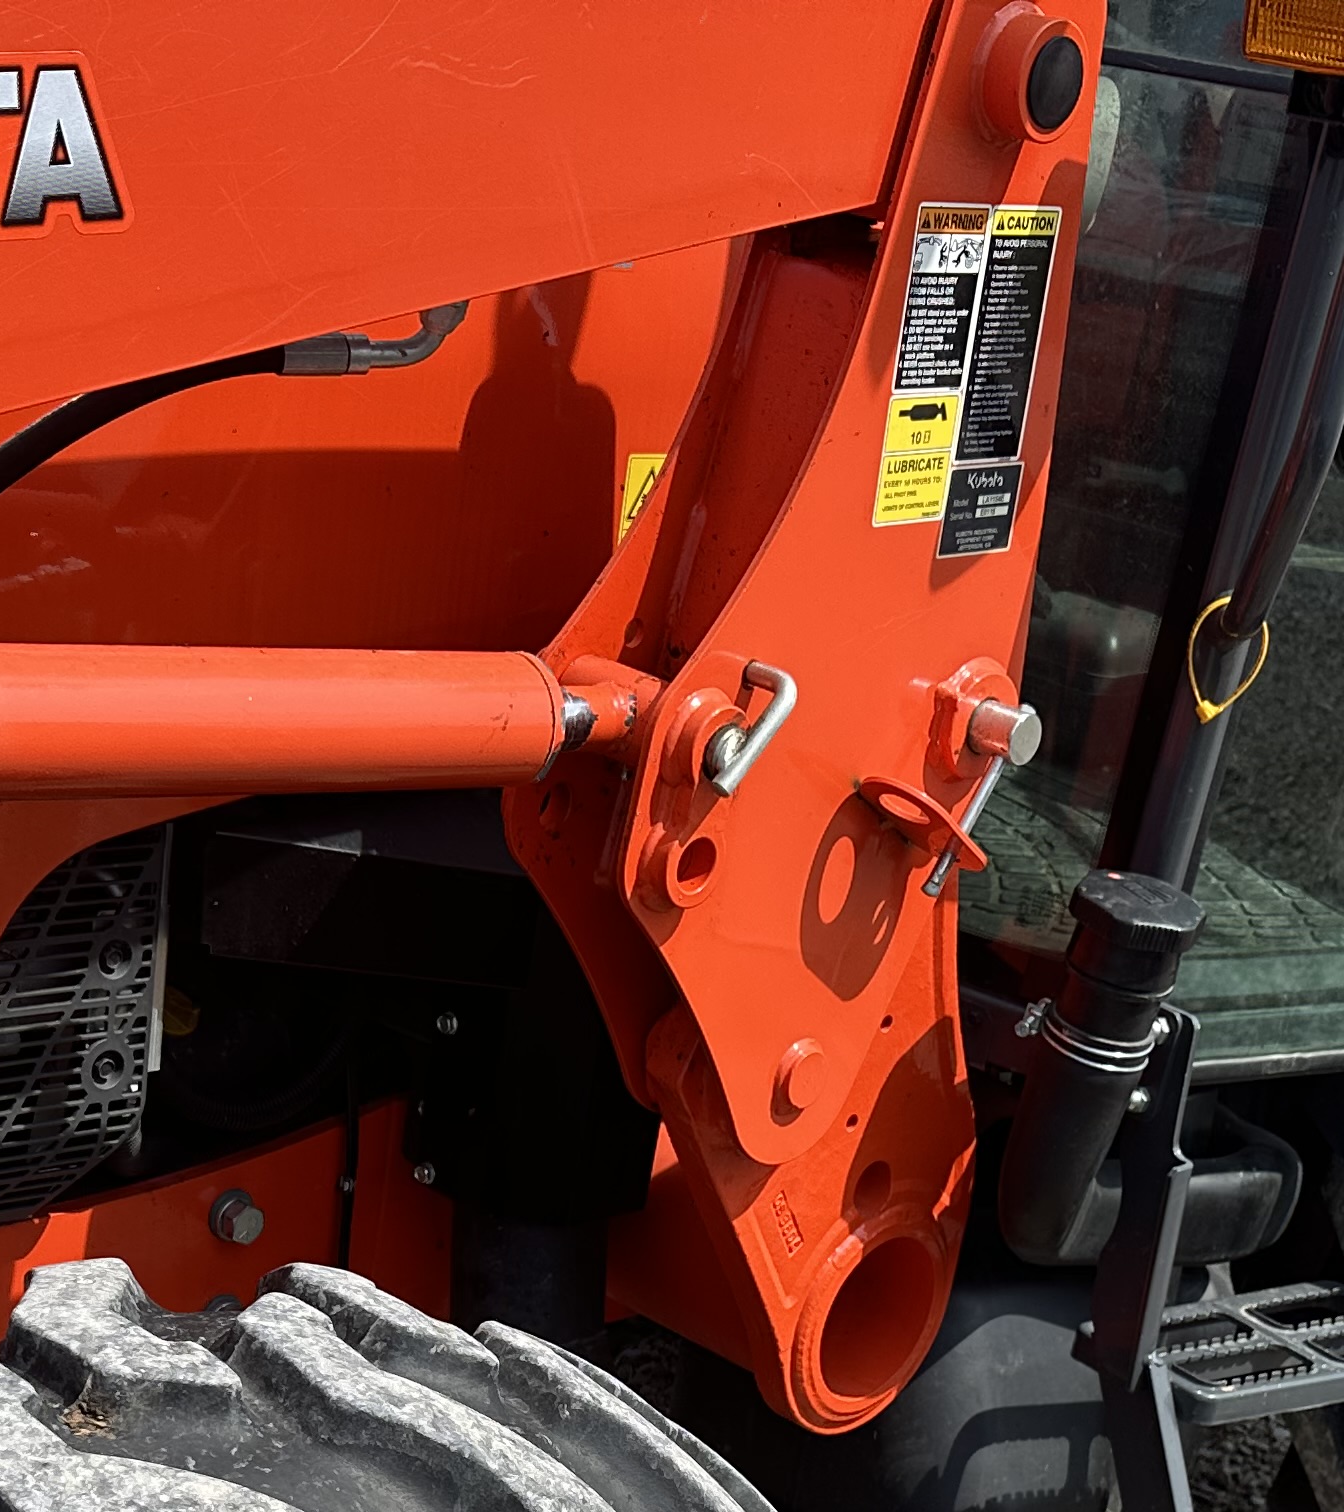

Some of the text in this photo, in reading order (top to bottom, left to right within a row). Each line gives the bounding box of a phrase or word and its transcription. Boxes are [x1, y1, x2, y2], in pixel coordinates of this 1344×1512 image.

[933, 212, 984, 230] WARNING
[1006, 215, 1054, 230] CAUTION
[909, 430, 922, 444] 10
[886, 456, 944, 473] LUBRICATE
[965, 470, 1005, 489] Kubota
